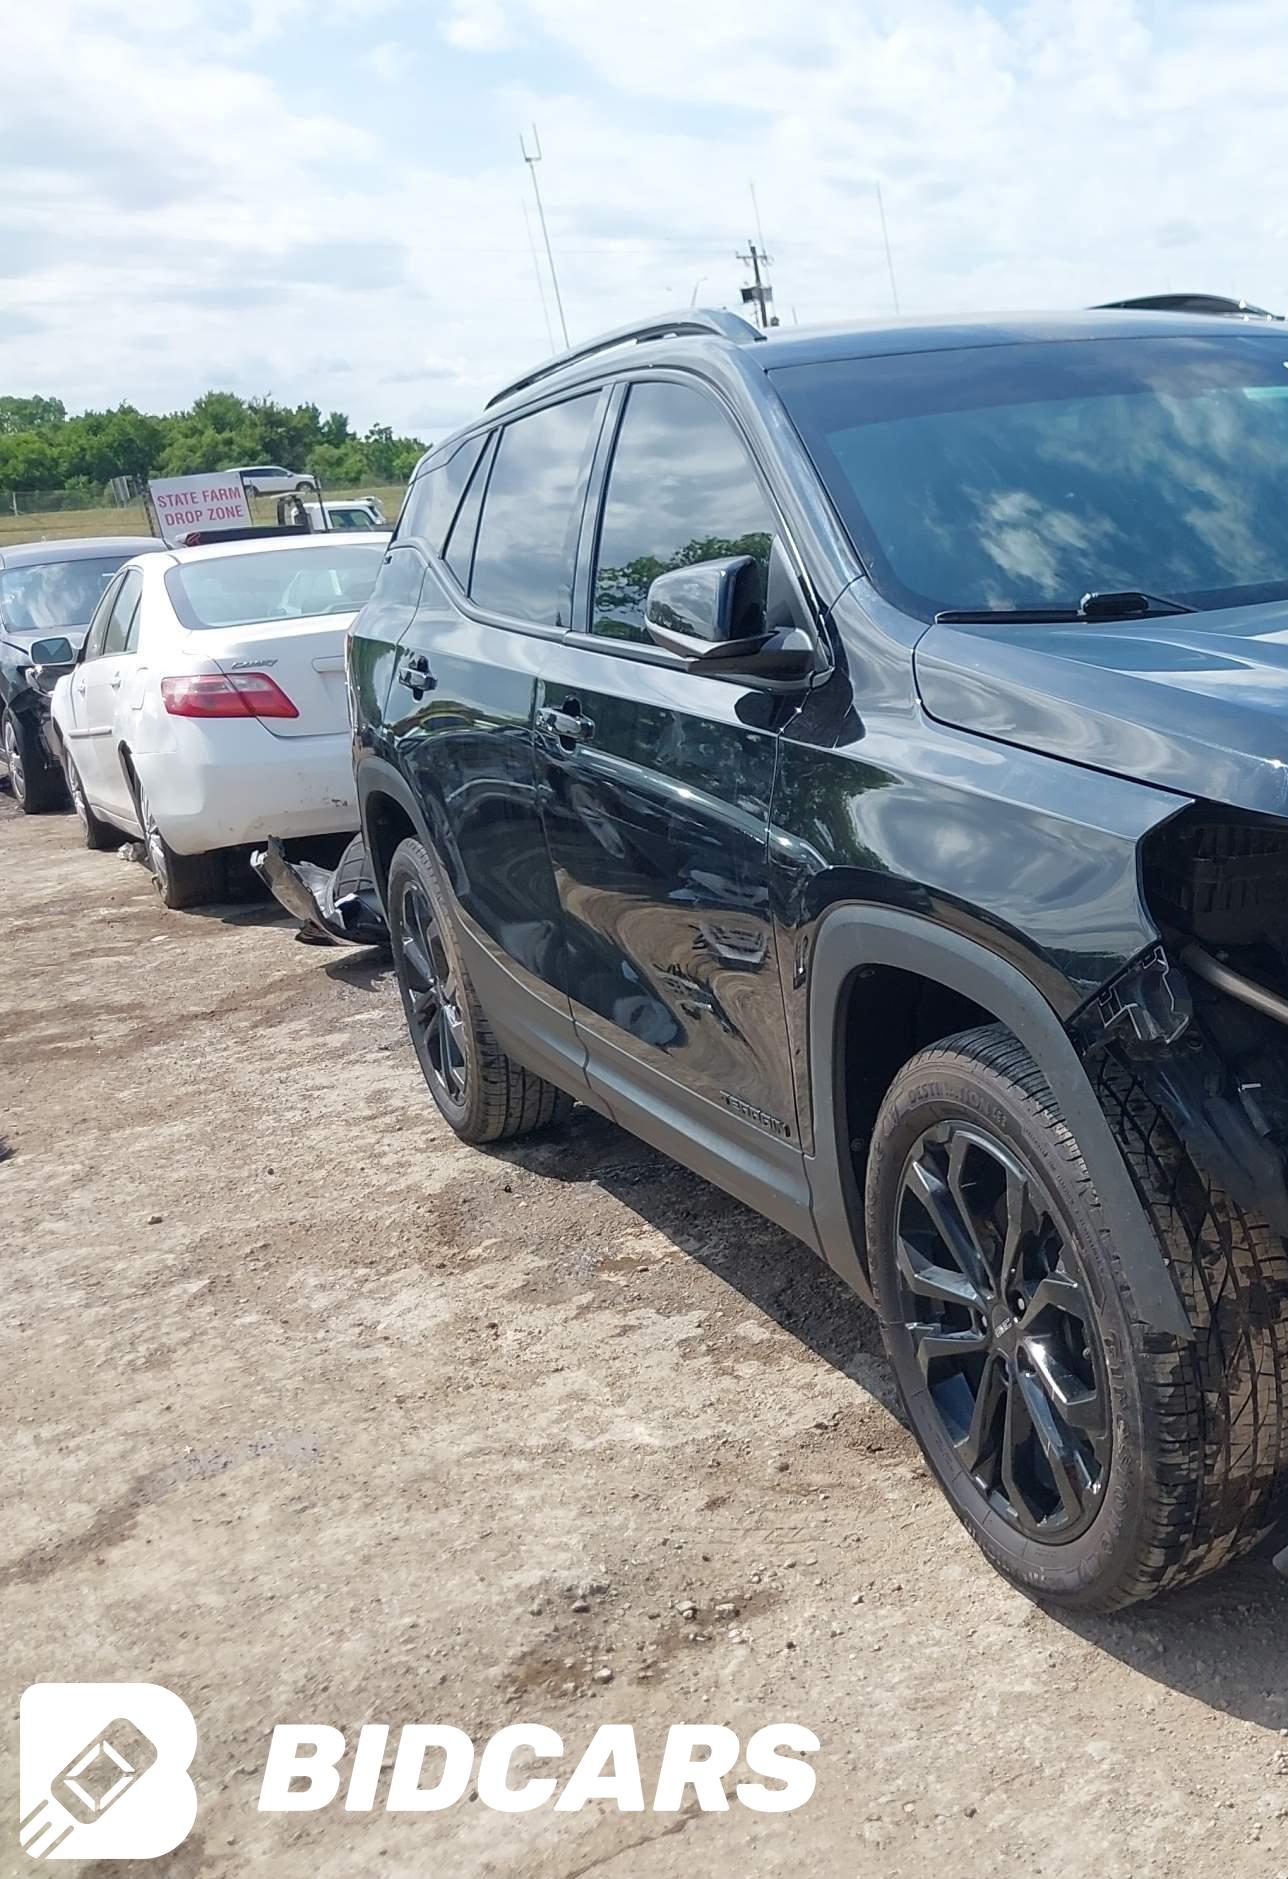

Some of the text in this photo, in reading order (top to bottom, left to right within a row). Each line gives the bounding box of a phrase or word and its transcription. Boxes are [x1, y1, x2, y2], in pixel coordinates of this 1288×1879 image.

[157, 487, 241, 508] STATE FARM
[165, 505, 244, 526] DROP ZONE
